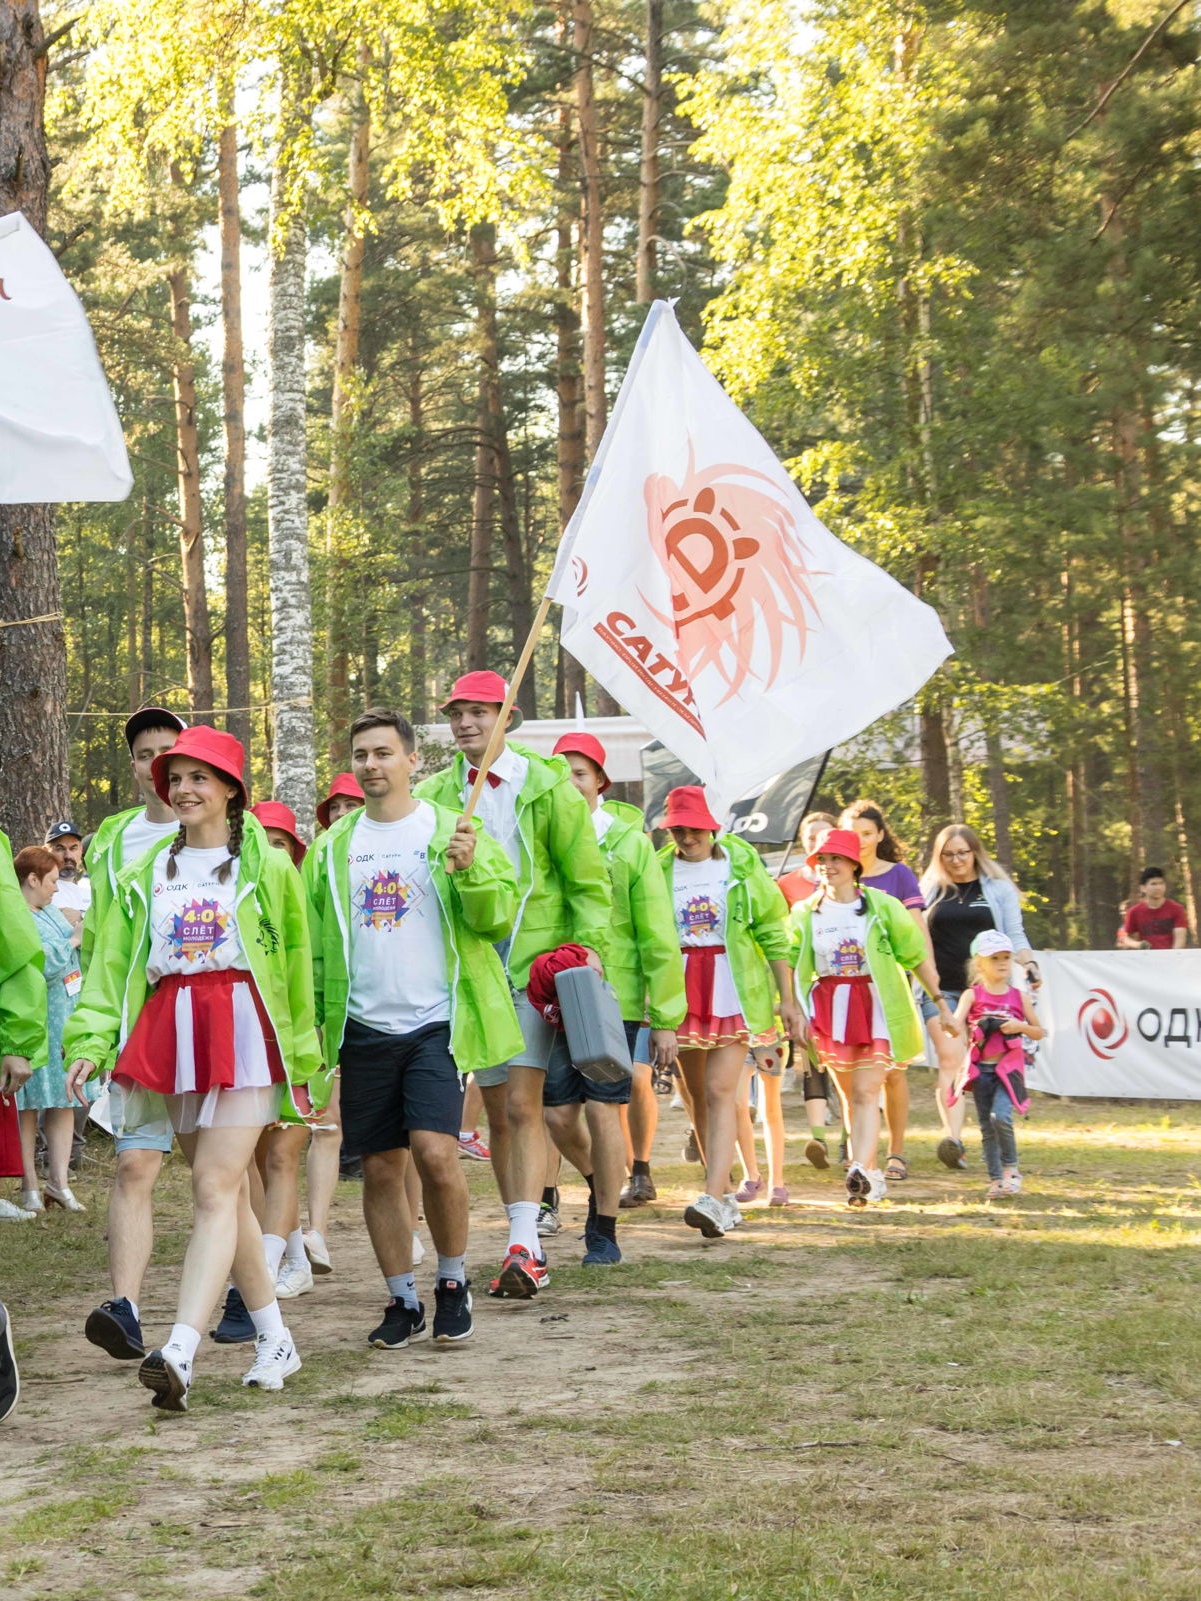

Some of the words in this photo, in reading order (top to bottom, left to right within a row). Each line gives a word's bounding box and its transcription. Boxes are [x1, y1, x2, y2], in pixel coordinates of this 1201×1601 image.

[605, 611, 701, 720] САТУ
[356, 854, 375, 863] ОДК
[373, 882, 397, 895] 4:0
[373, 897, 396, 906] СЛЁТ
[183, 909, 215, 923] 4:0
[183, 926, 214, 935] СЛЁТ
